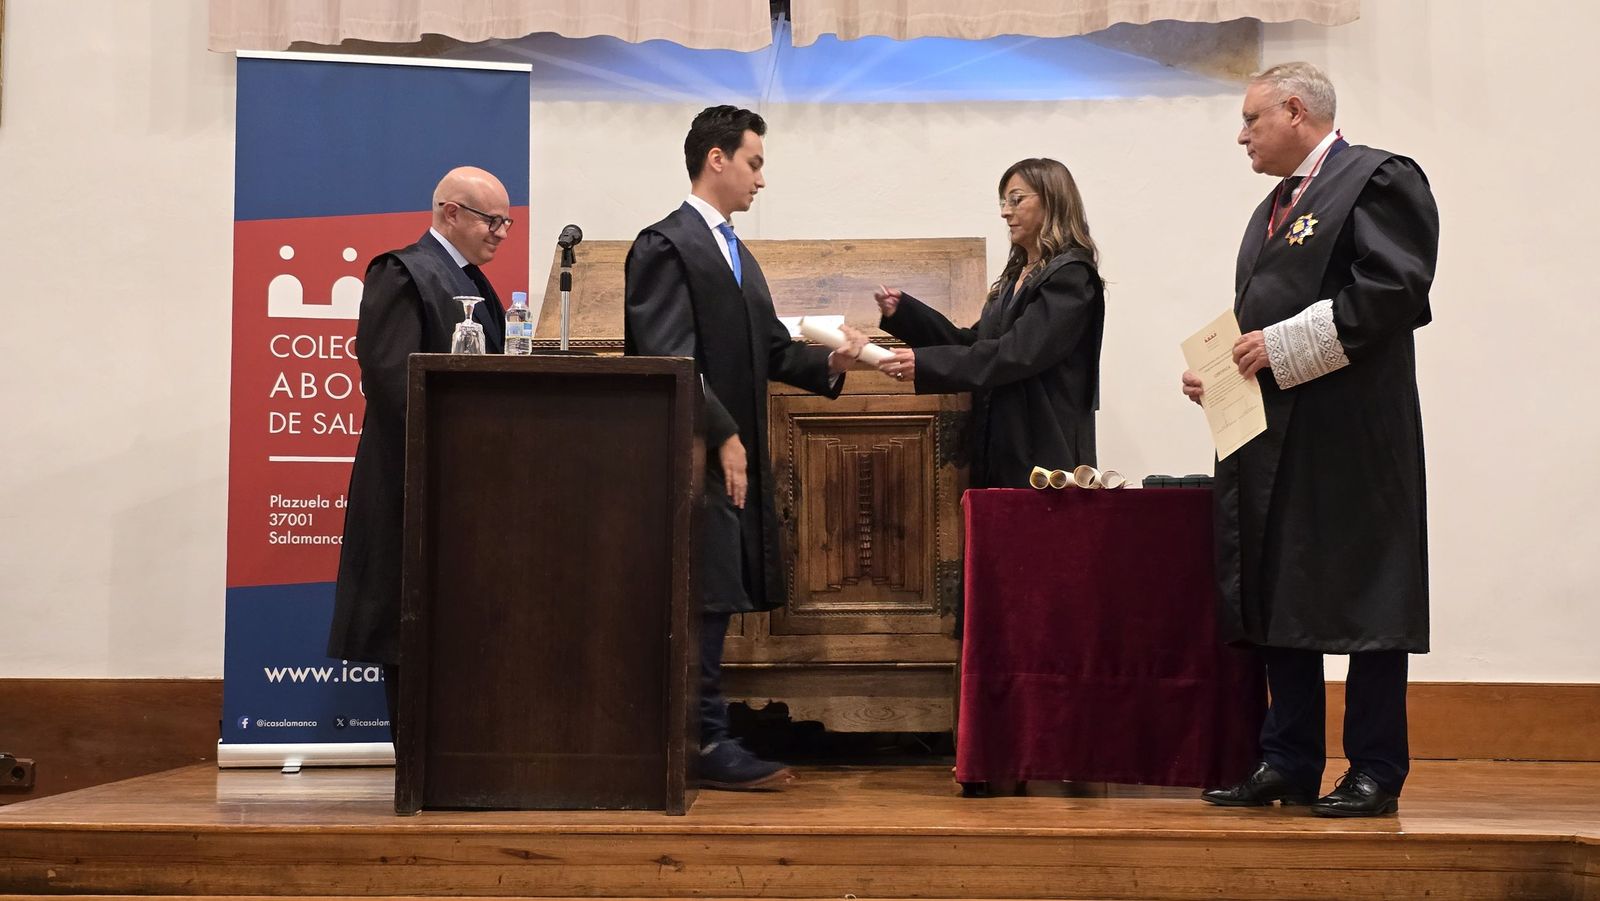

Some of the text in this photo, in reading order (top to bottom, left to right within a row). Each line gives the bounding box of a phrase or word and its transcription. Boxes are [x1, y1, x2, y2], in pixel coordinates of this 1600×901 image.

[269, 371, 365, 399] ABO
[269, 411, 363, 435] DE SAL
[270, 494, 330, 508] Plazuela
[269, 513, 313, 526] 37001
[264, 659, 385, 683] www.ica
[256, 718, 318, 728] @icasalamanca
